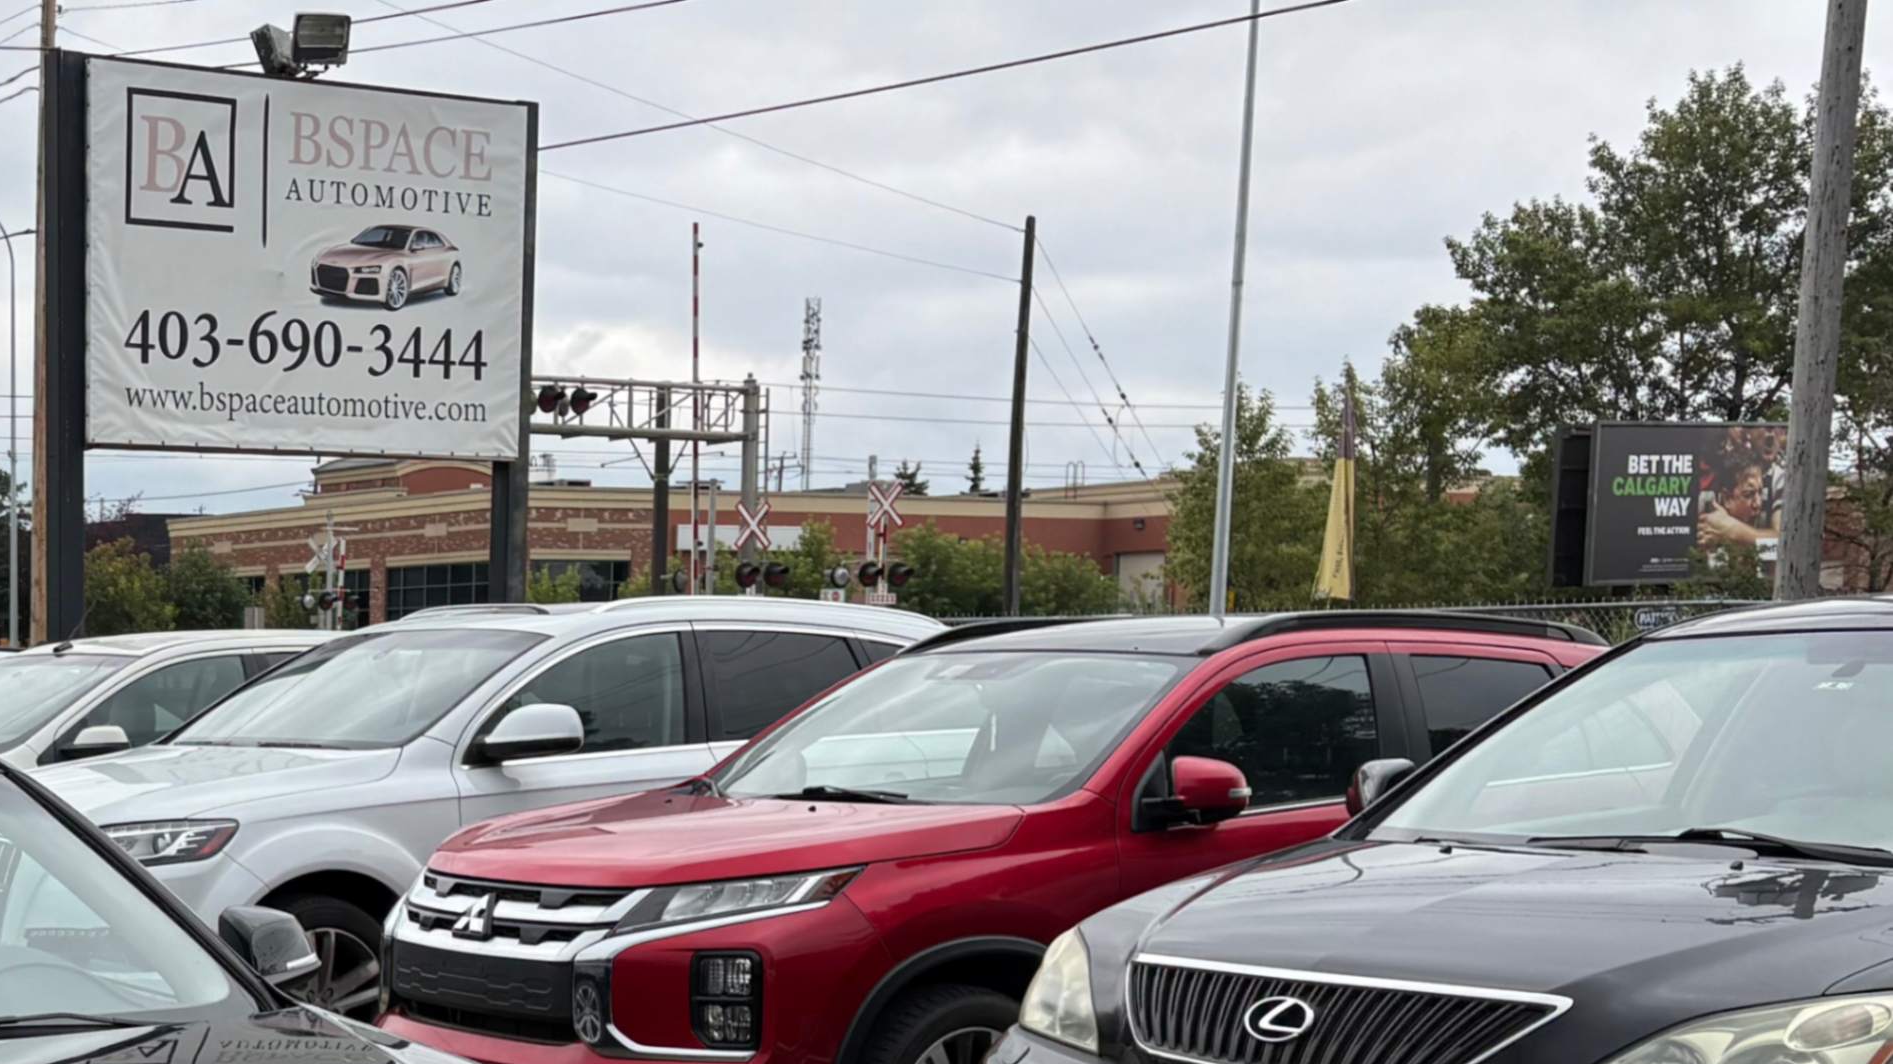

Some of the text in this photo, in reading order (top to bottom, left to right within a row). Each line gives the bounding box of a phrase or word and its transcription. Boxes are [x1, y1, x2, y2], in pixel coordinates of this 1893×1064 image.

[139, 115, 235, 208] BA
[288, 111, 493, 182] BSPACE
[285, 178, 493, 217] AUTOMOTIVE
[124, 309, 488, 381] 403-690-3444
[125, 382, 487, 422] www.bspaceautomotive.com
[1628, 455, 1693, 474] BET THE
[1612, 476, 1692, 496] CALGARY
[1654, 497, 1691, 517] WAY
